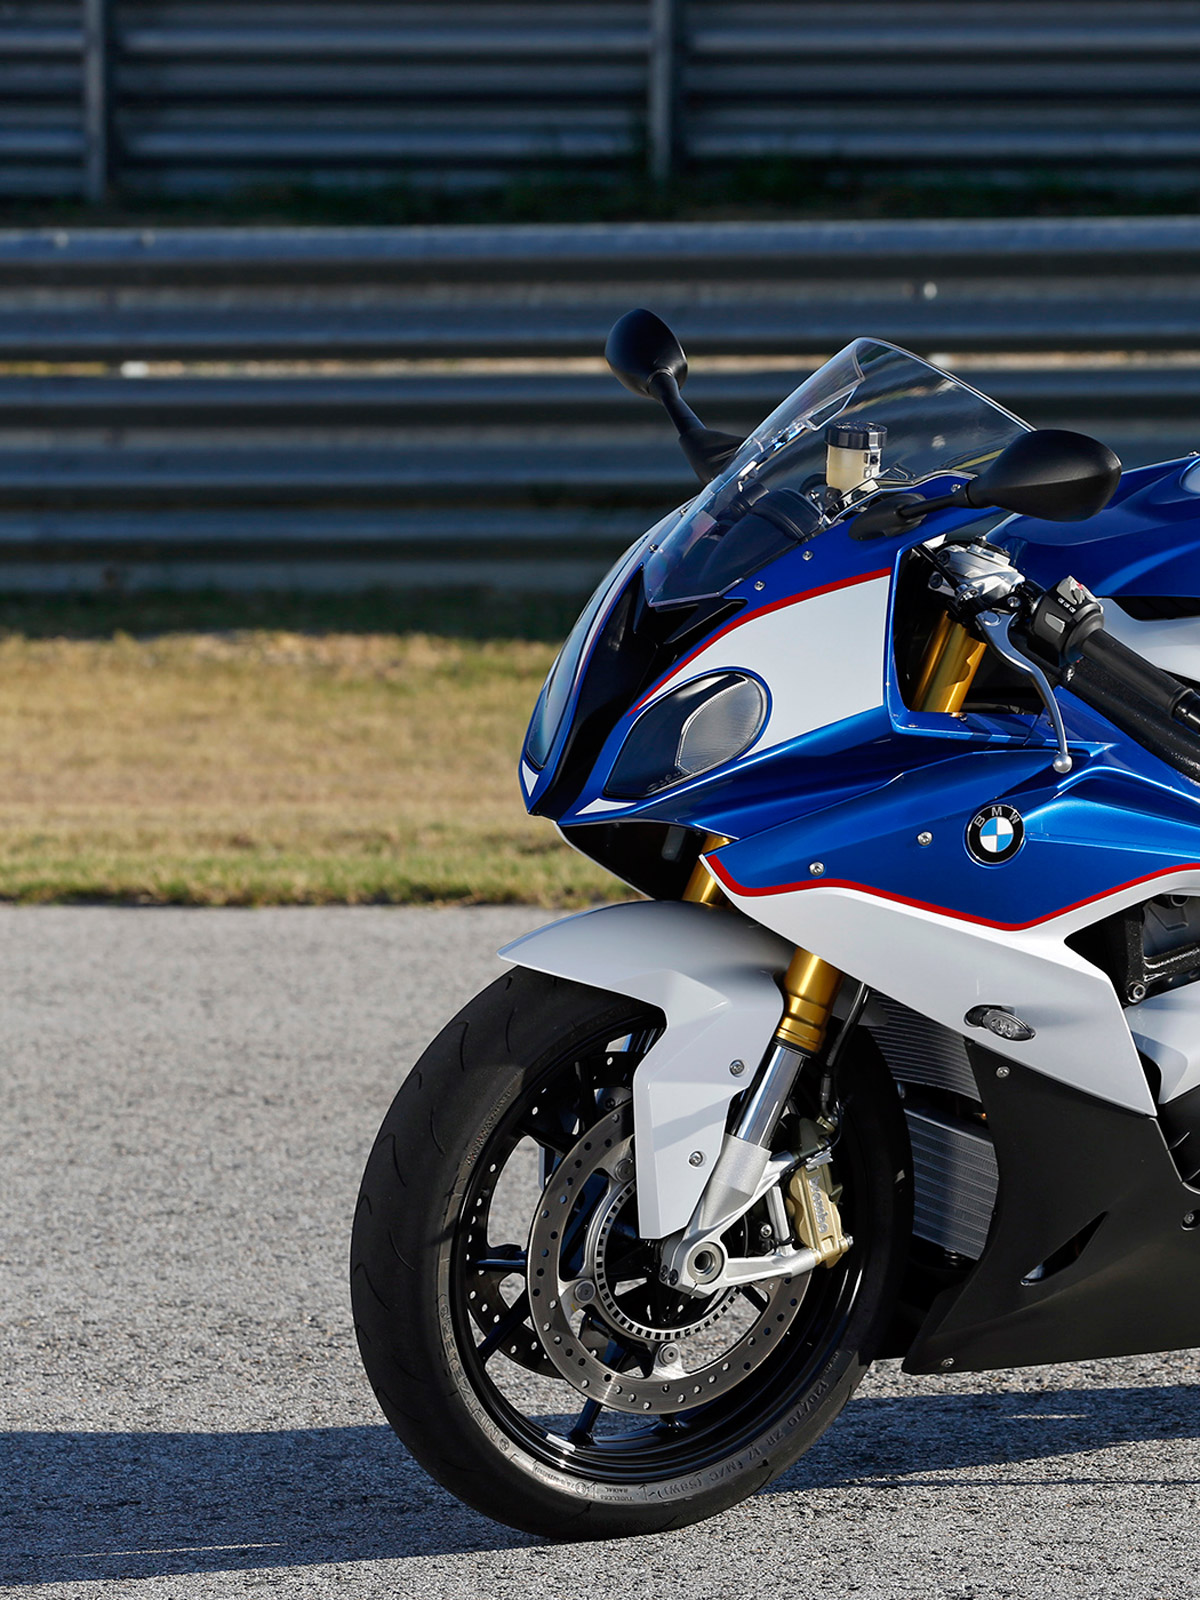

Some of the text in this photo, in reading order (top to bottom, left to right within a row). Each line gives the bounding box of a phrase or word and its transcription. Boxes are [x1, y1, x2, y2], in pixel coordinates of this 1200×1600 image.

[973, 806, 1020, 828] BMW
[808, 1175, 829, 1234] brembo
[440, 1323, 499, 1442] METZELER
[787, 1379, 829, 1428] 120/70
[767, 1430, 785, 1446] ZR
